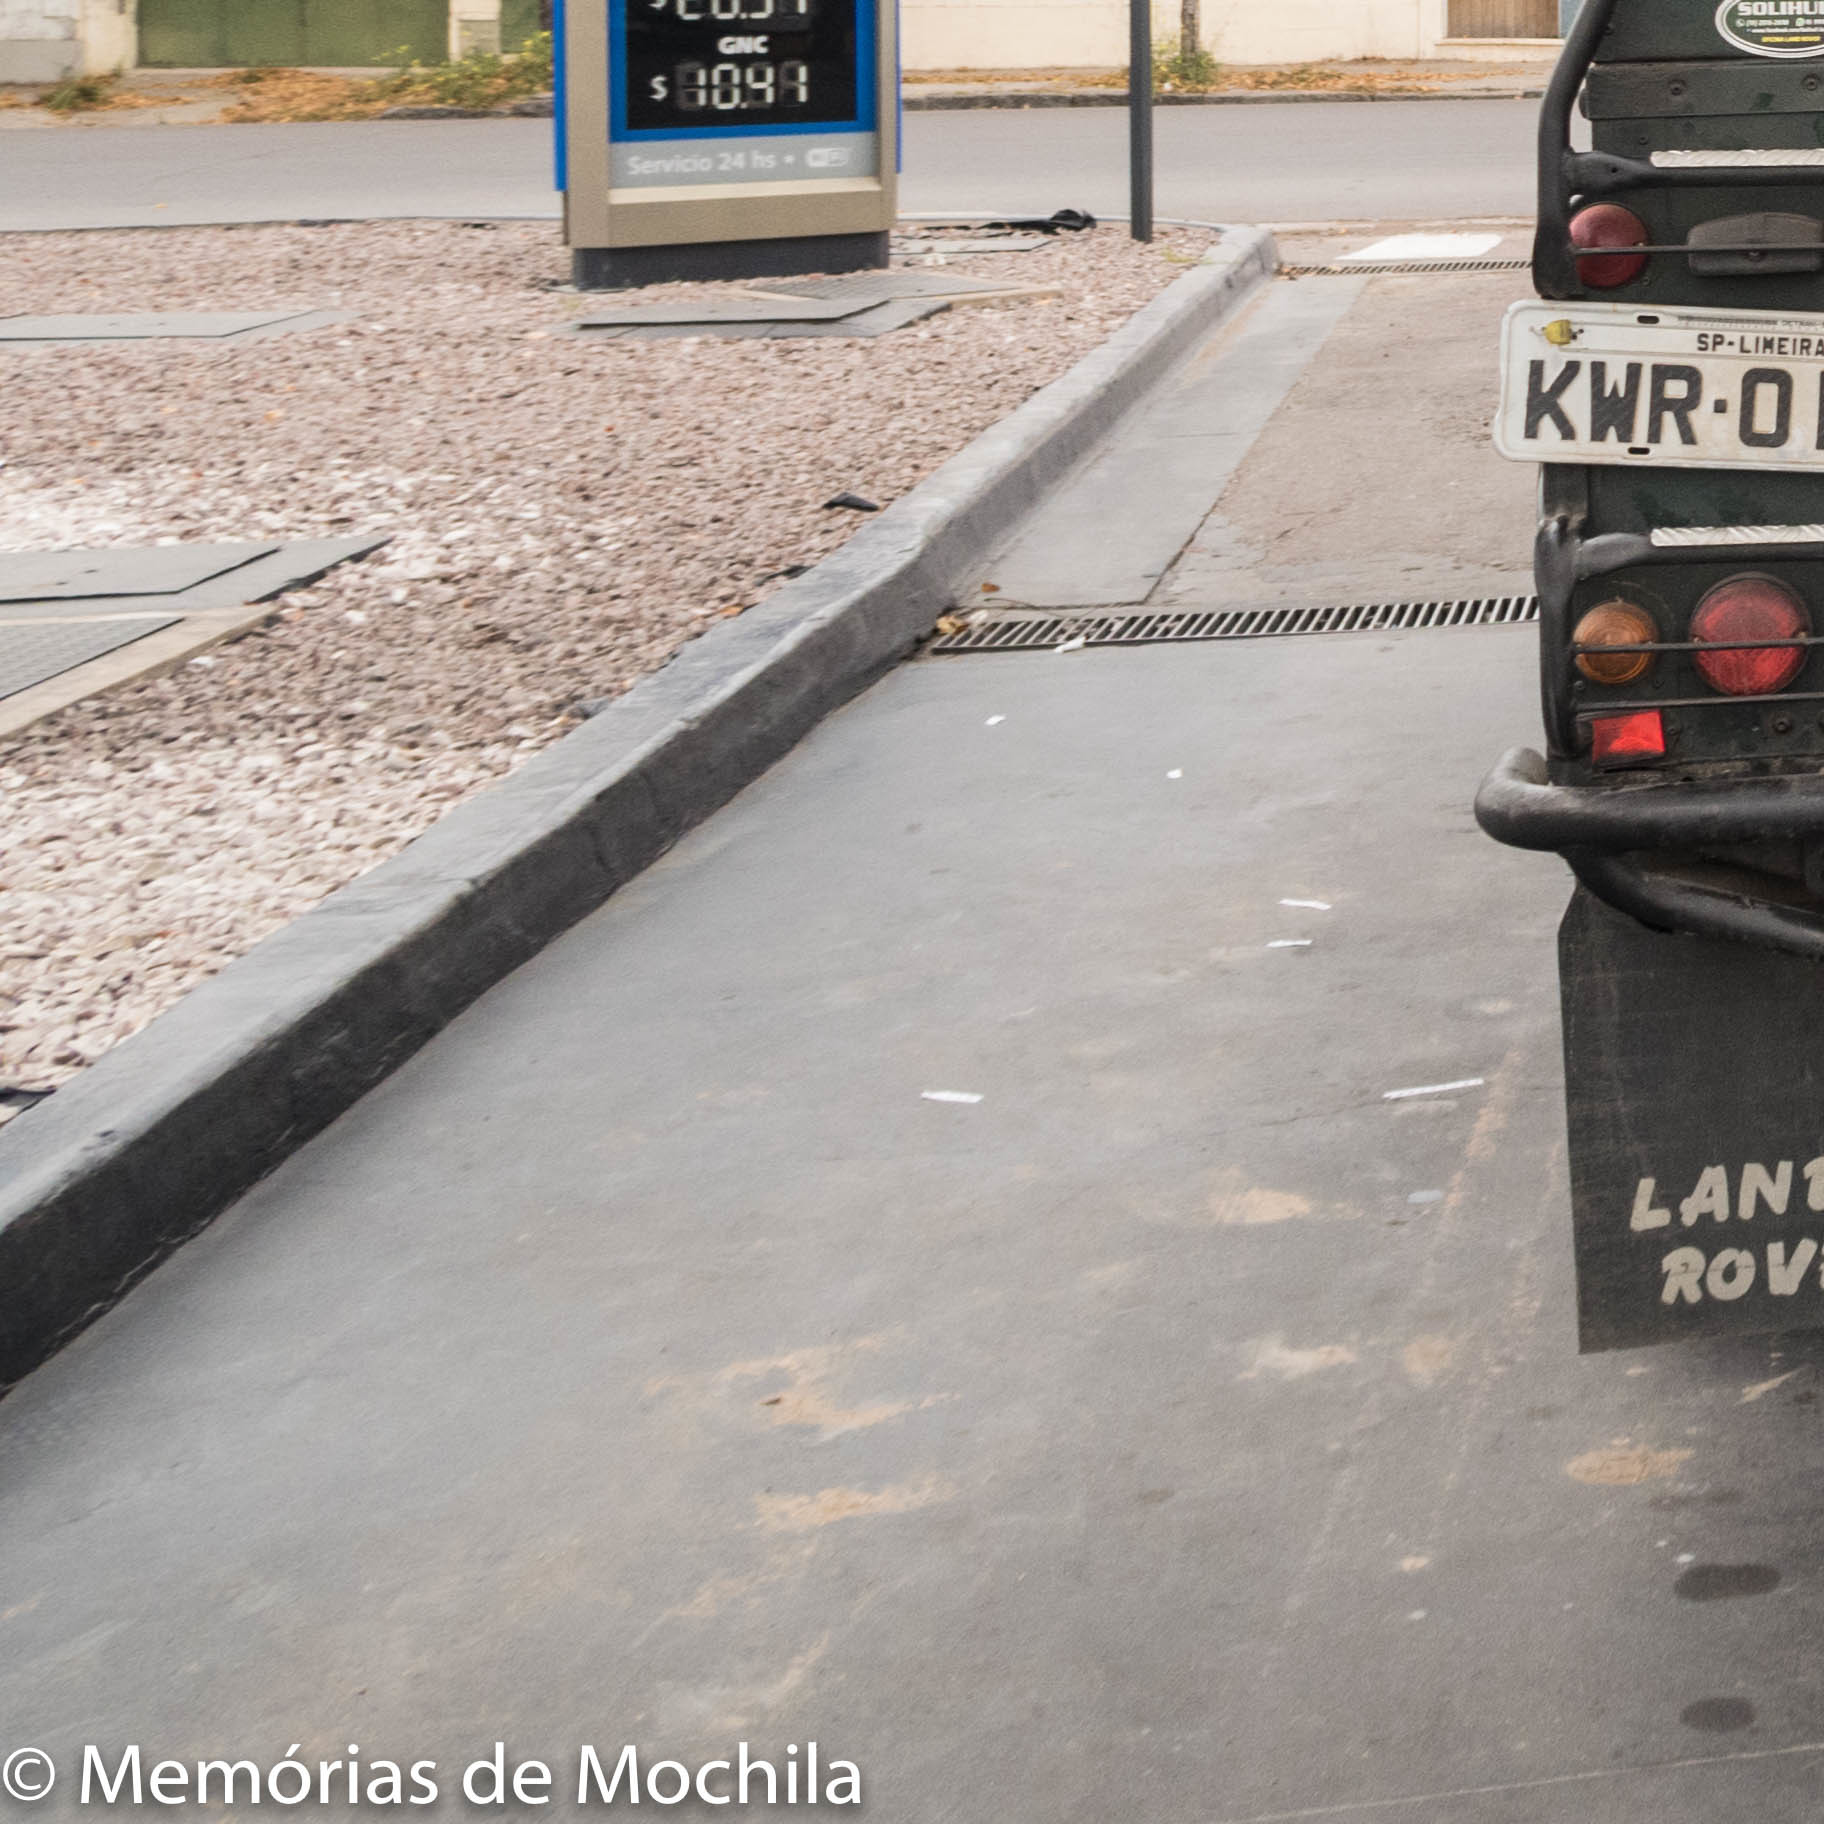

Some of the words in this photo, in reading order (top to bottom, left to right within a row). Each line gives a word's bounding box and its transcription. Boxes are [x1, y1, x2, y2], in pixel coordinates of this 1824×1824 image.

[717, 35, 770, 55] GNC
[627, 154, 712, 176] Servicio
[716, 151, 746, 171] 24
[751, 150, 777, 170] hs
